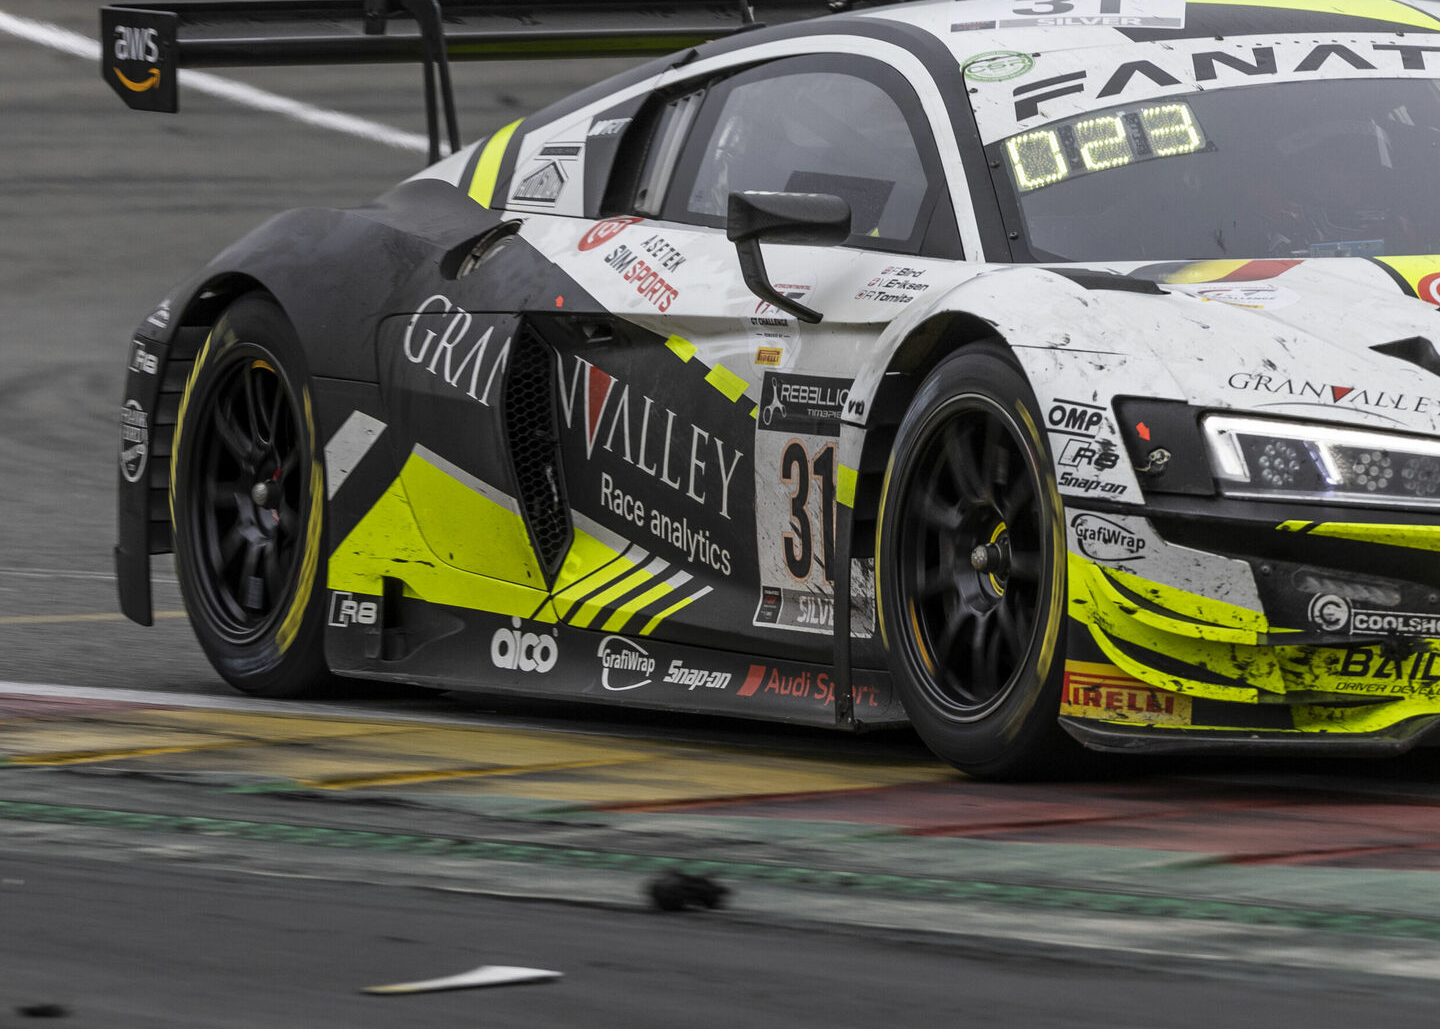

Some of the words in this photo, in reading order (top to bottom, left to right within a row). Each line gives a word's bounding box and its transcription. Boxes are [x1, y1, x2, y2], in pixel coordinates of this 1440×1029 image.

[1037, 16, 1141, 27] SILVER
[1006, 103, 1202, 191] 023
[640, 235, 687, 273] ASETEK
[604, 244, 638, 273] SIM
[623, 260, 679, 312] SPORTS
[898, 267, 926, 278] Bird
[781, 383, 850, 406] REBELLIO
[1048, 405, 1103, 432] OMP
[1071, 446, 1120, 471] R8
[1058, 472, 1127, 494] Snap-on
[601, 472, 645, 527] Race
[650, 508, 731, 576] analytics
[780, 438, 835, 585] 31
[1075, 522, 1146, 554] GrafiWrap
[339, 599, 378, 624] R8
[490, 616, 558, 673] aico
[602, 648, 655, 677] GrafiWrap
[663, 660, 732, 690] Snap-on
[764, 668, 811, 699] Audi
[1336, 681, 1386, 693] DRIVER
